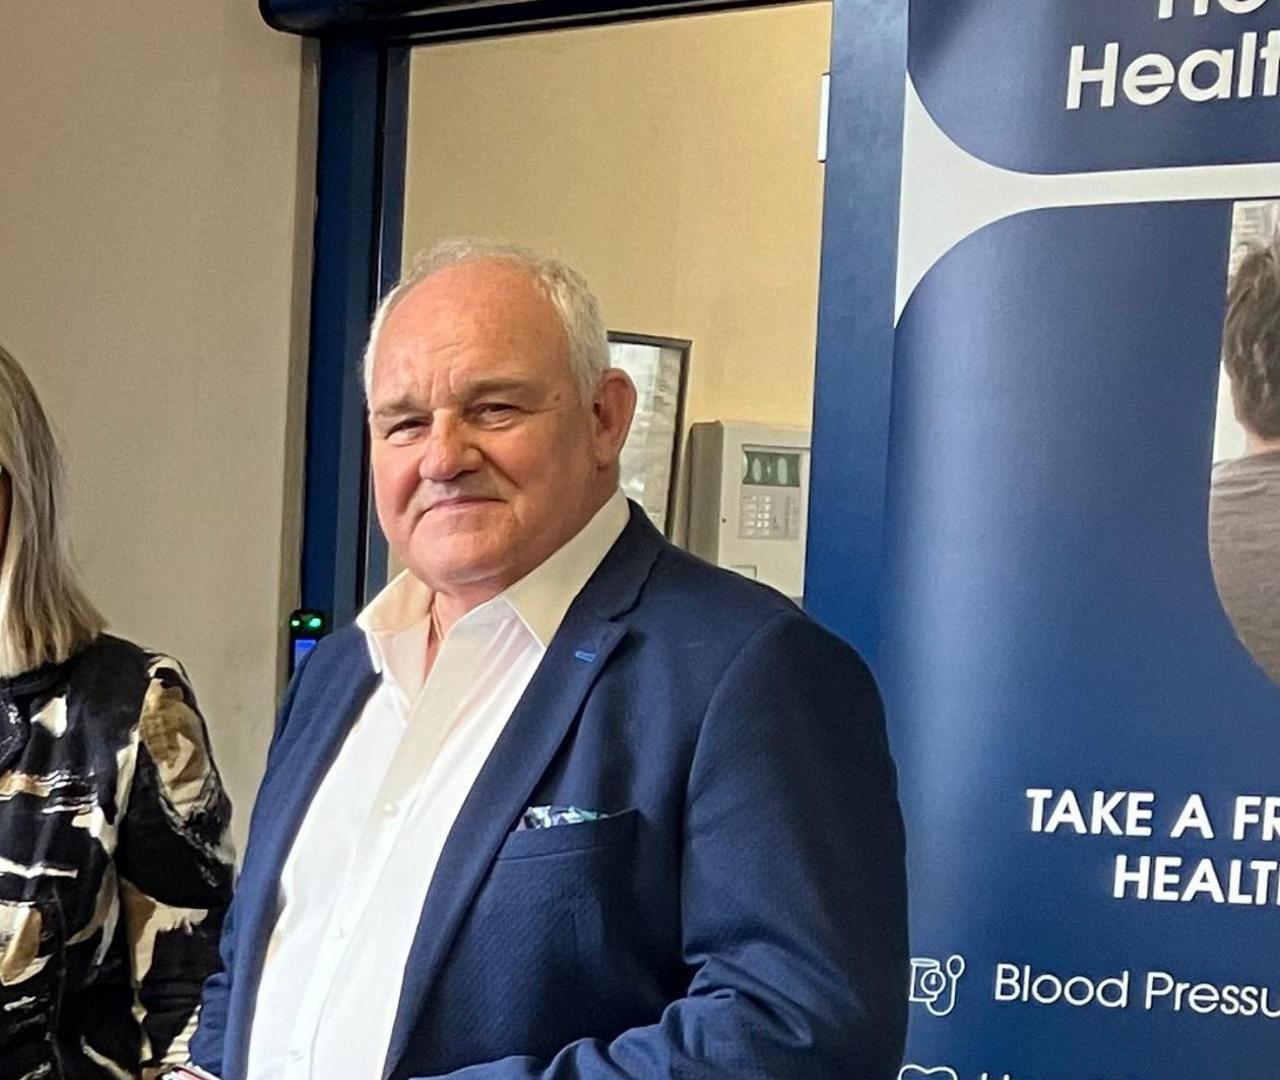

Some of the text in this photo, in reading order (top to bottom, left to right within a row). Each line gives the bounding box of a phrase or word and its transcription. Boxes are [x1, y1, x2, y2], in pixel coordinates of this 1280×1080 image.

[1026, 788, 1155, 837] TAKE
[1169, 794, 1215, 839] A
[1113, 854, 1280, 905] HEALT
[994, 963, 1129, 1008] Blood
